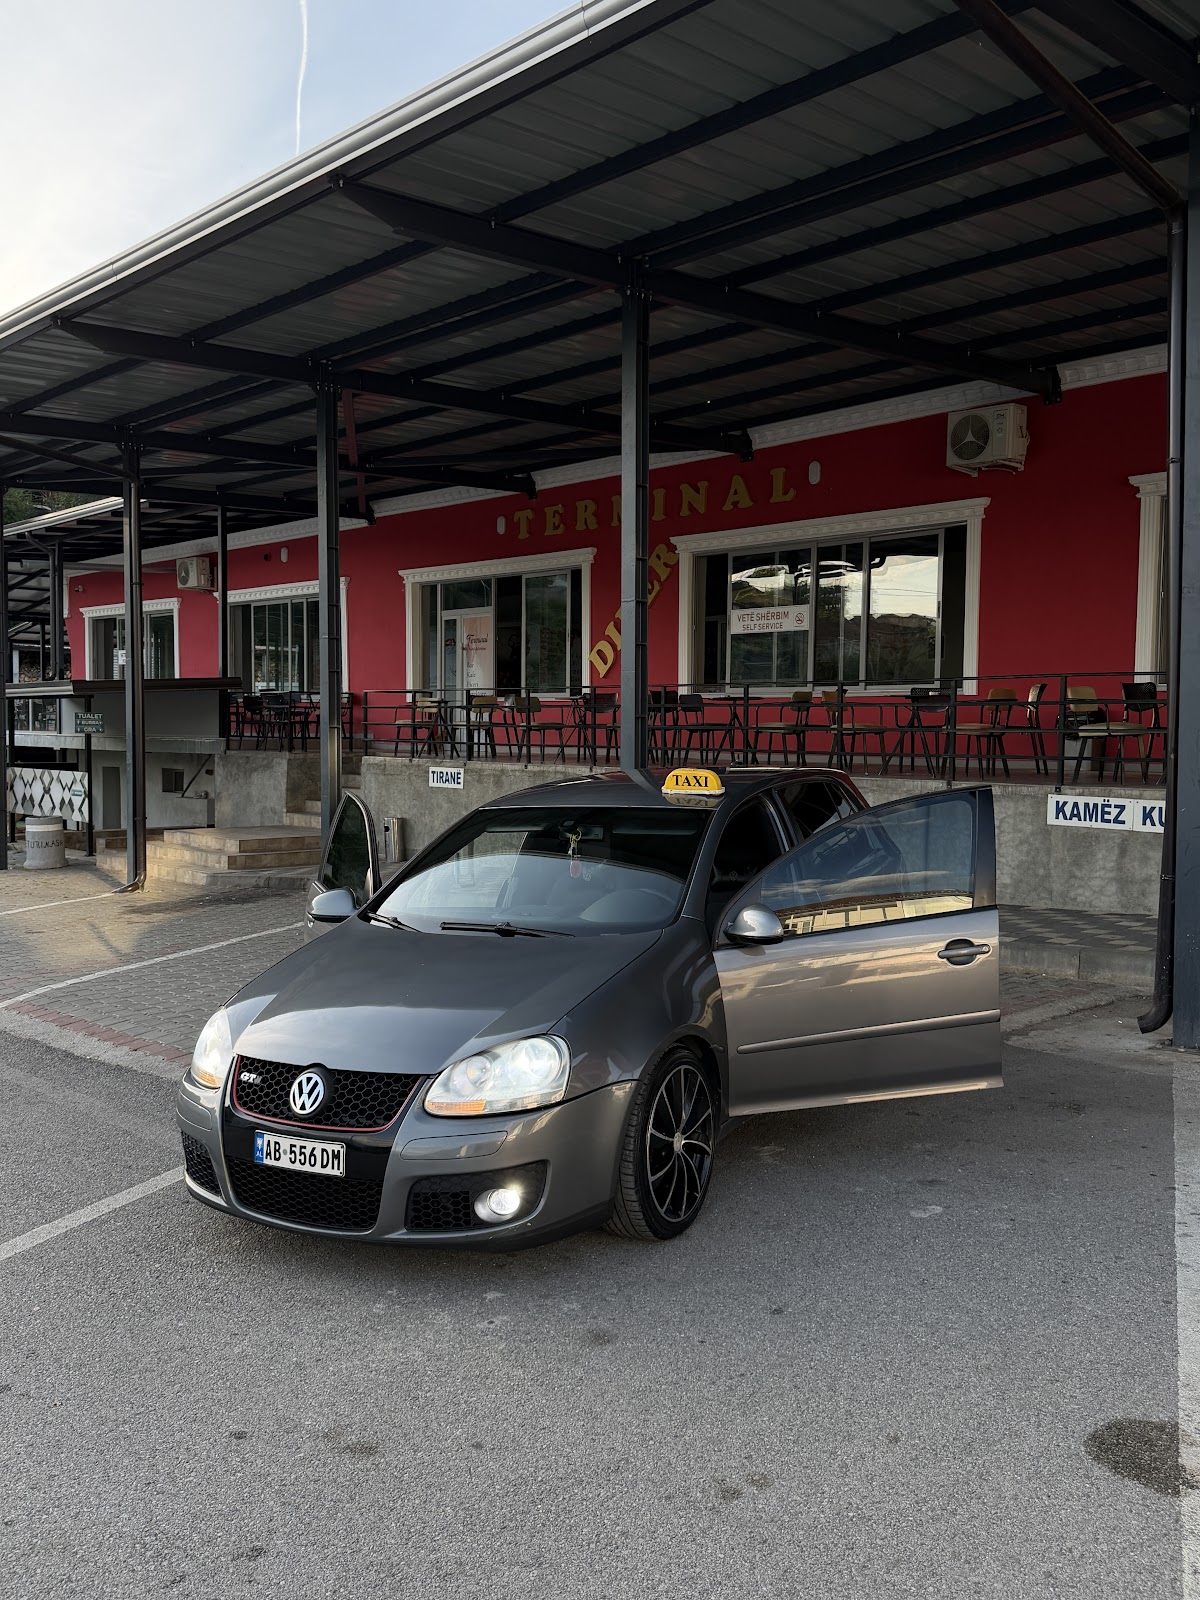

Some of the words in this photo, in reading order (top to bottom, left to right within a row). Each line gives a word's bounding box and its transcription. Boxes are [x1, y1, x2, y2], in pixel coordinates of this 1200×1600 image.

[588, 543, 679, 679] DIR
[737, 611, 755, 622] VETË
[755, 610, 789, 621] SHËRBIM
[742, 623, 757, 631] SELF
[758, 622, 783, 630] SERVICE
[431, 769, 462, 785] TIRANË
[673, 775, 709, 788] TAXI
[1055, 798, 1126, 825] KAMËZ
